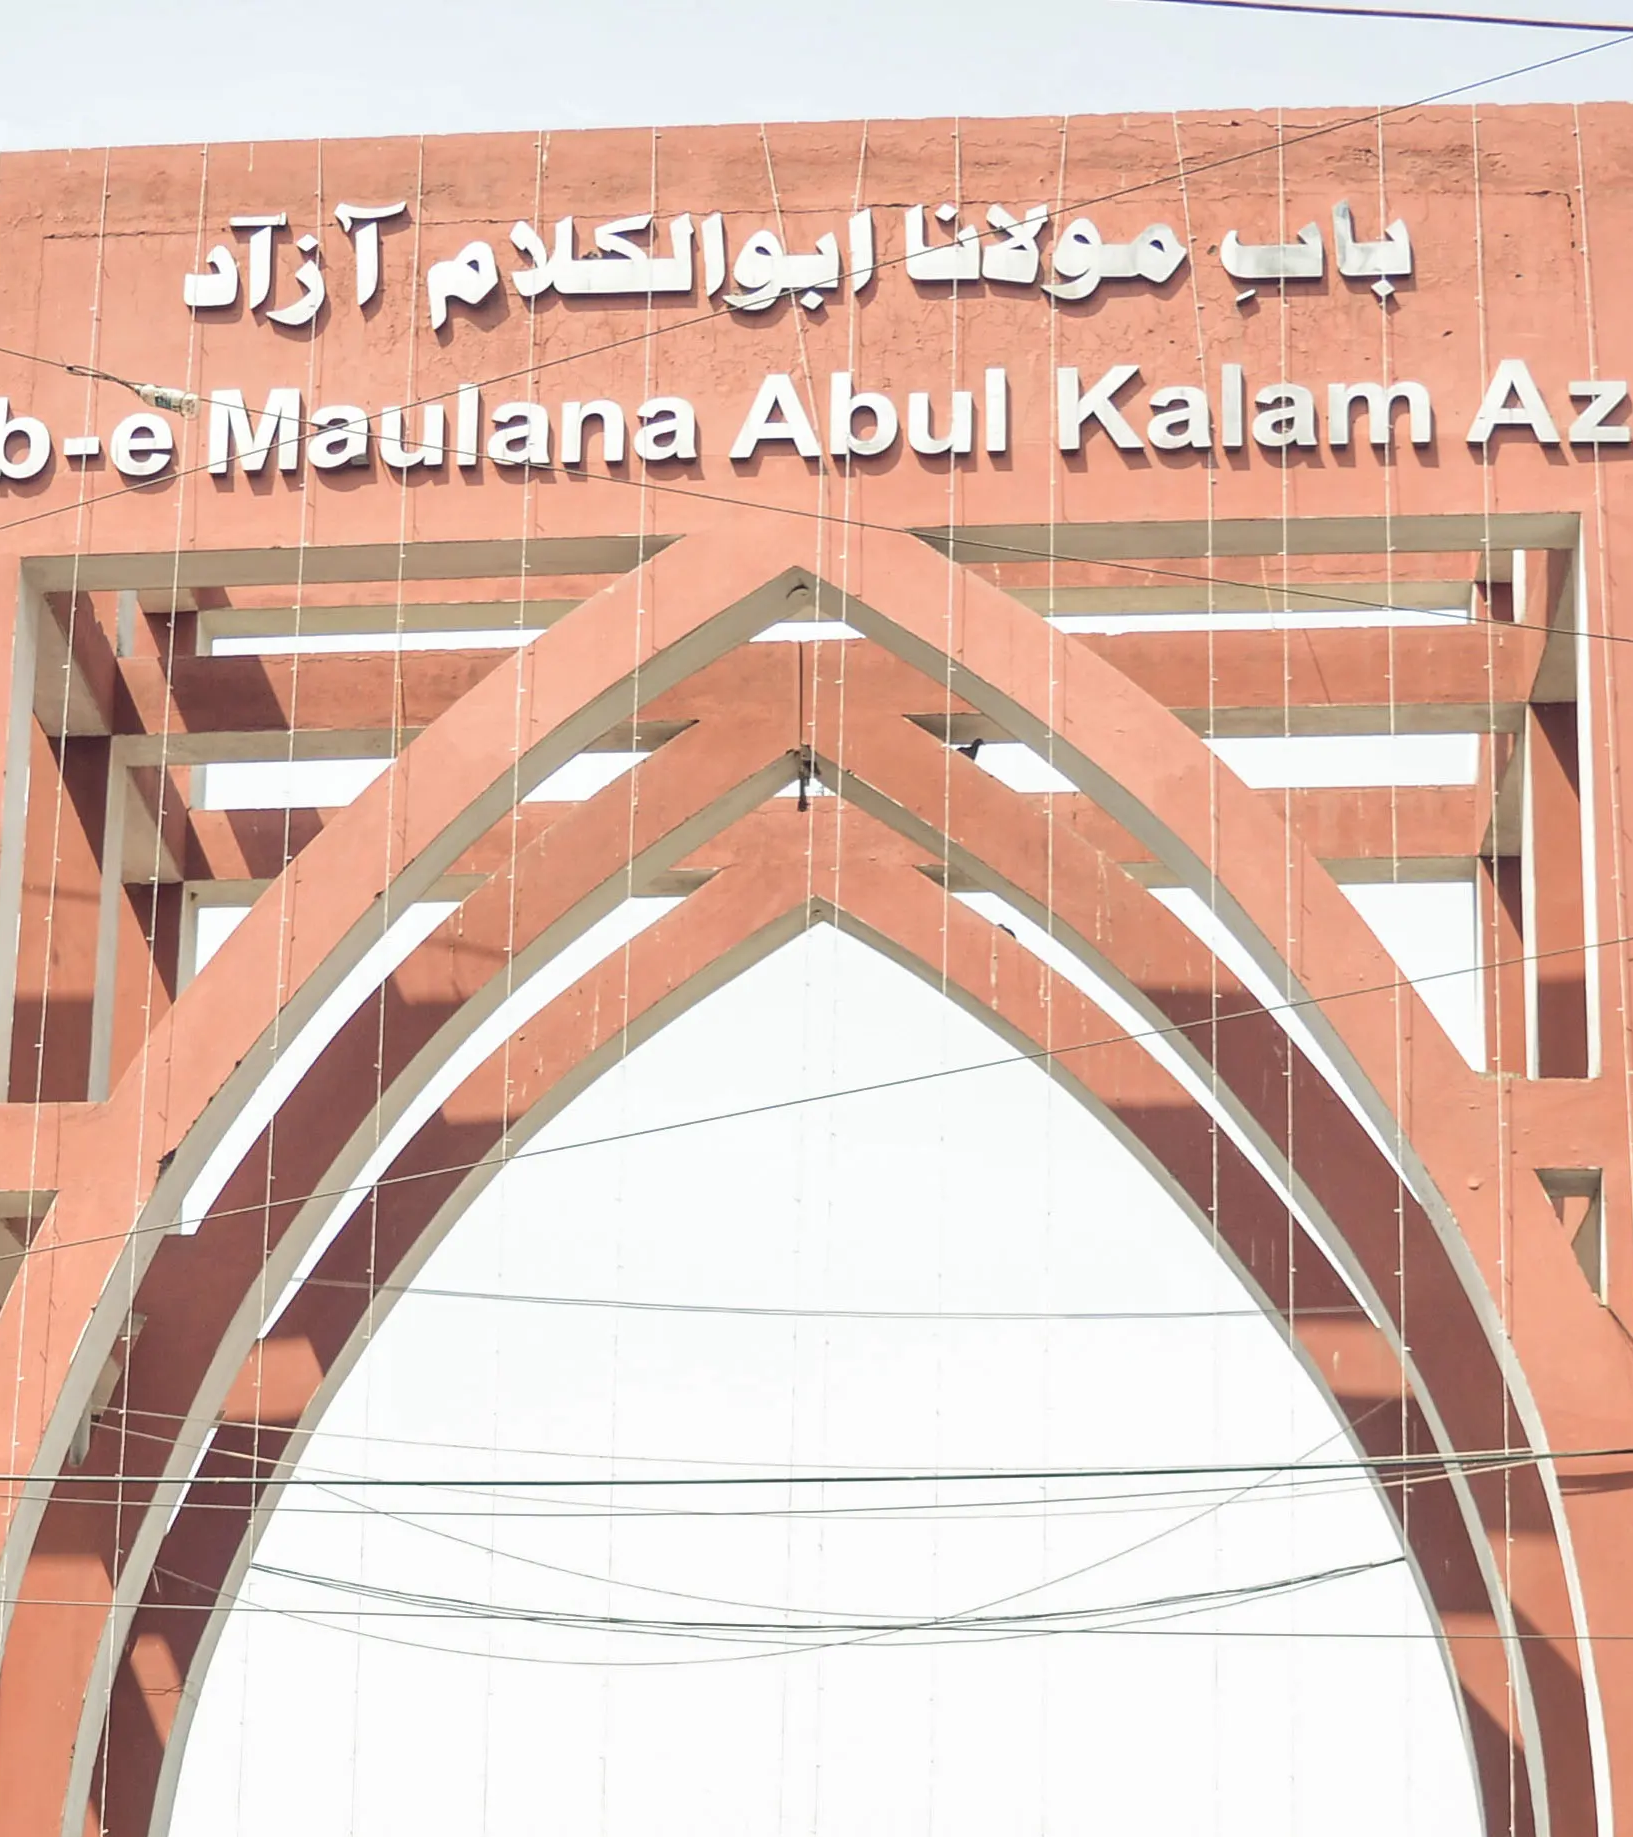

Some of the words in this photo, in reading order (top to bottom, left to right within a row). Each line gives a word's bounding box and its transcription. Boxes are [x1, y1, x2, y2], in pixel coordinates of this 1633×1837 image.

[905, 203, 1187, 300] مولانا
[1220, 199, 1412, 302] باب
[208, 383, 698, 476] Maulana
[728, 368, 1007, 460] Abul
[1057, 362, 1431, 452] Kalam
